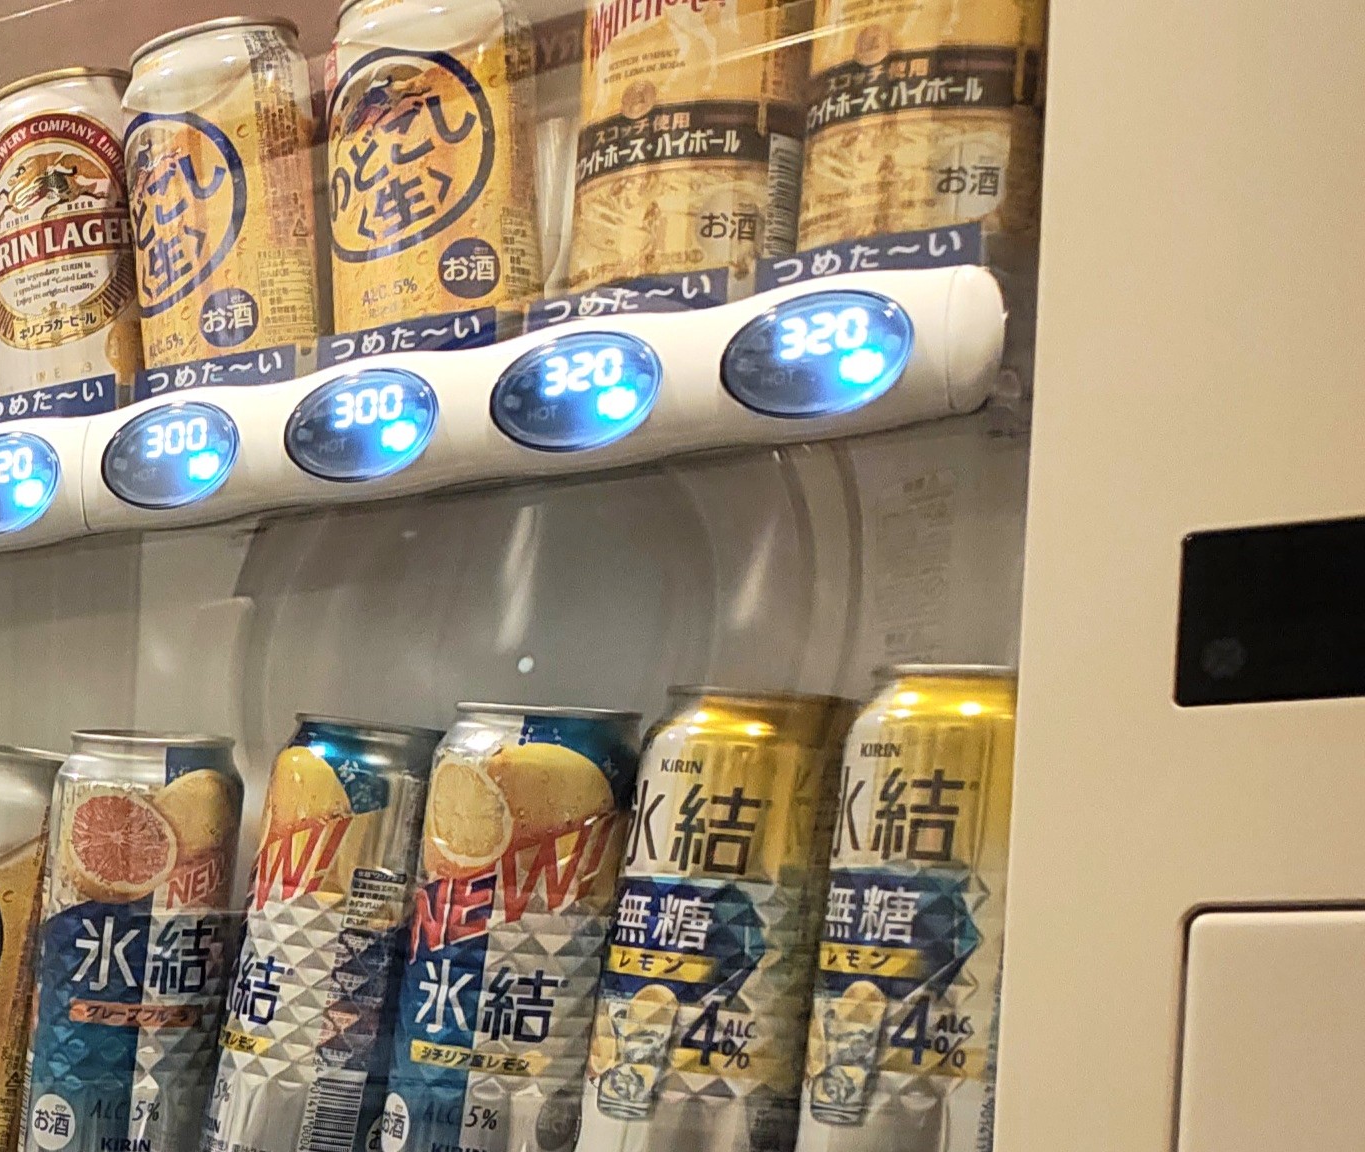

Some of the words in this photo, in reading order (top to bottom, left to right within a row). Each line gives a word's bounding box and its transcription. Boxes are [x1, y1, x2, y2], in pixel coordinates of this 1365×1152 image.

[29, 118, 96, 144] COMPANY,
[596, 112, 691, 147] スコッチ使用
[936, 165, 1001, 197] お酒
[699, 211, 759, 241] お酒
[443, 253, 496, 283] お酒
[42, 285, 69, 301] original
[69, 281, 97, 295] quality.
[391, 277, 419, 297] 5%
[19, 311, 98, 341] キリンラガービール
[203, 304, 255, 333] お酒
[779, 306, 870, 362] 320
[543, 347, 624, 397] 320
[334, 384, 404, 429] 300
[145, 416, 209, 459] 300
[860, 742, 902, 758] KIRIN
[660, 757, 703, 775] KIRIN
[625, 778, 762, 876] 氷結
[409, 812, 619, 963] NEW!
[614, 888, 715, 951] 無糖
[824, 883, 922, 946] 無糖
[72, 916, 216, 995] 氷結
[618, 949, 686, 975] レモン
[823, 946, 892, 971] レモン
[415, 958, 569, 1043] 氷結
[419, 1043, 531, 1073] シチリア産レモン
[33, 1108, 71, 1138] お酒
[132, 1101, 161, 1122] 5%
[465, 1104, 497, 1131] 5%
[101, 1137, 152, 1152] KIRIN
